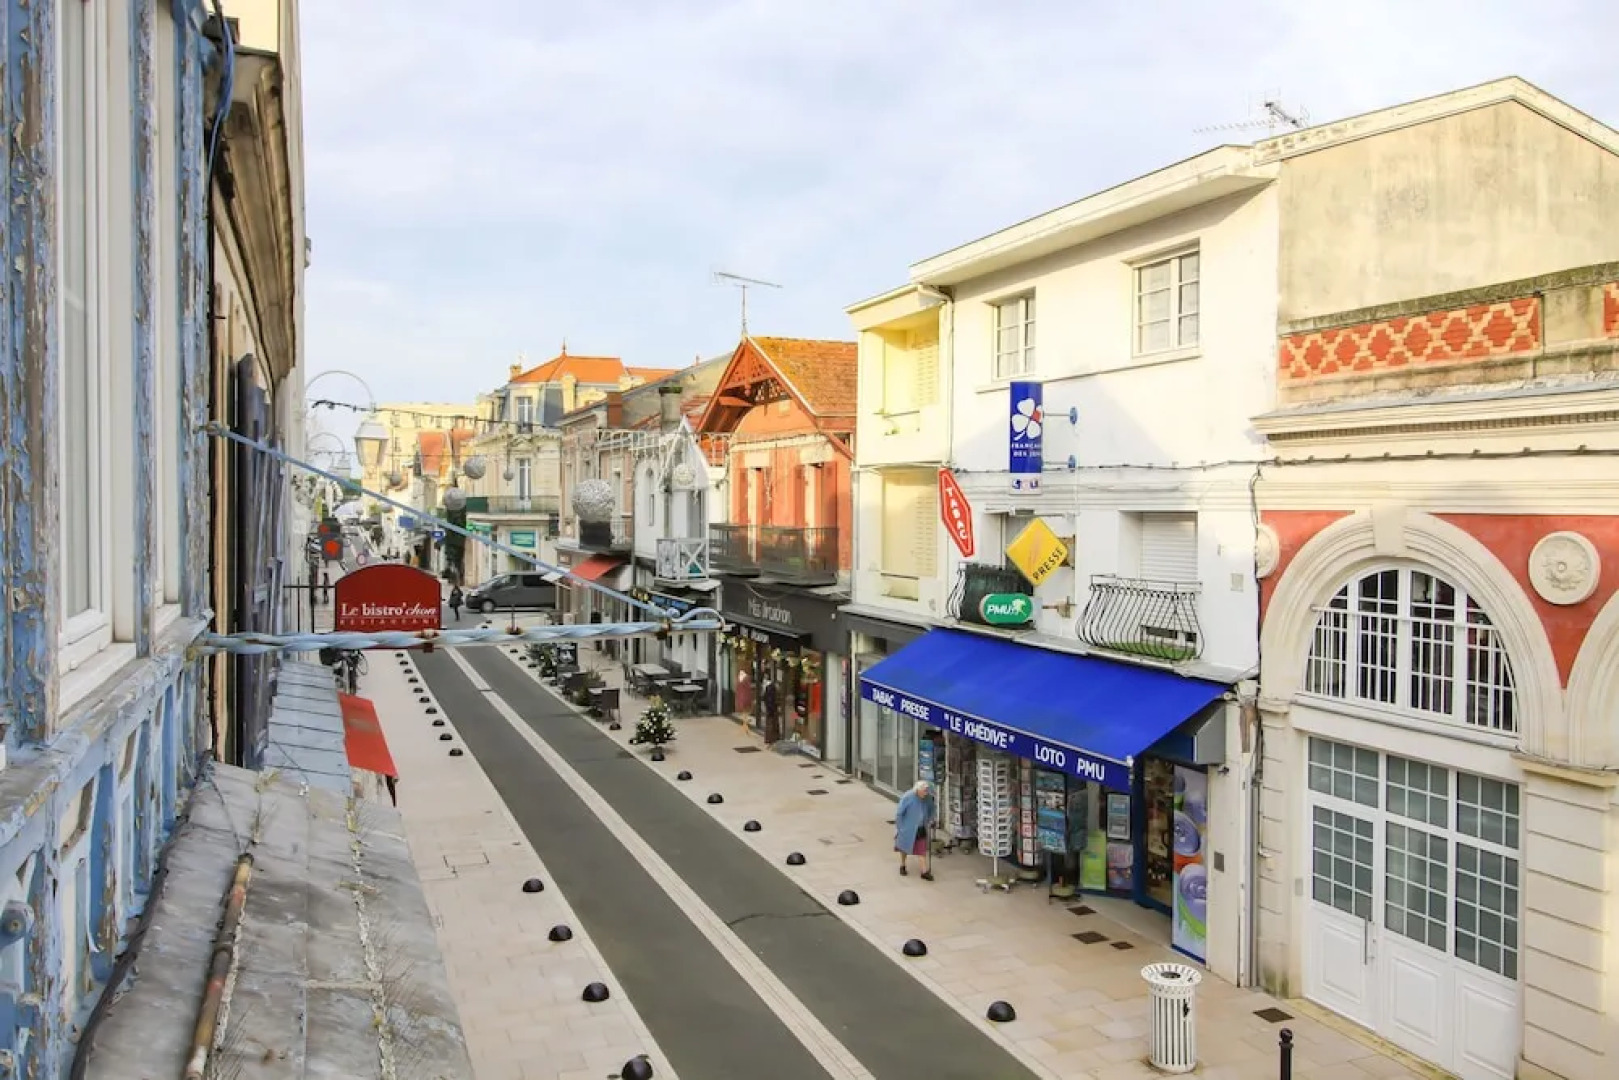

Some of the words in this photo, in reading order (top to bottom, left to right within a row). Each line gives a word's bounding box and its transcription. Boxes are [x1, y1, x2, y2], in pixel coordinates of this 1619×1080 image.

[945, 487, 968, 539] TABAC
[1032, 547, 1063, 580] PRESSE
[339, 618, 438, 626] RESTAURANT
[341, 603, 359, 616] Le
[361, 602, 437, 616] bistro'chon
[872, 688, 894, 708] TABAC
[901, 698, 930, 722] PRESSE
[1035, 744, 1066, 768] LOTO
[1077, 758, 1105, 781] PMU
